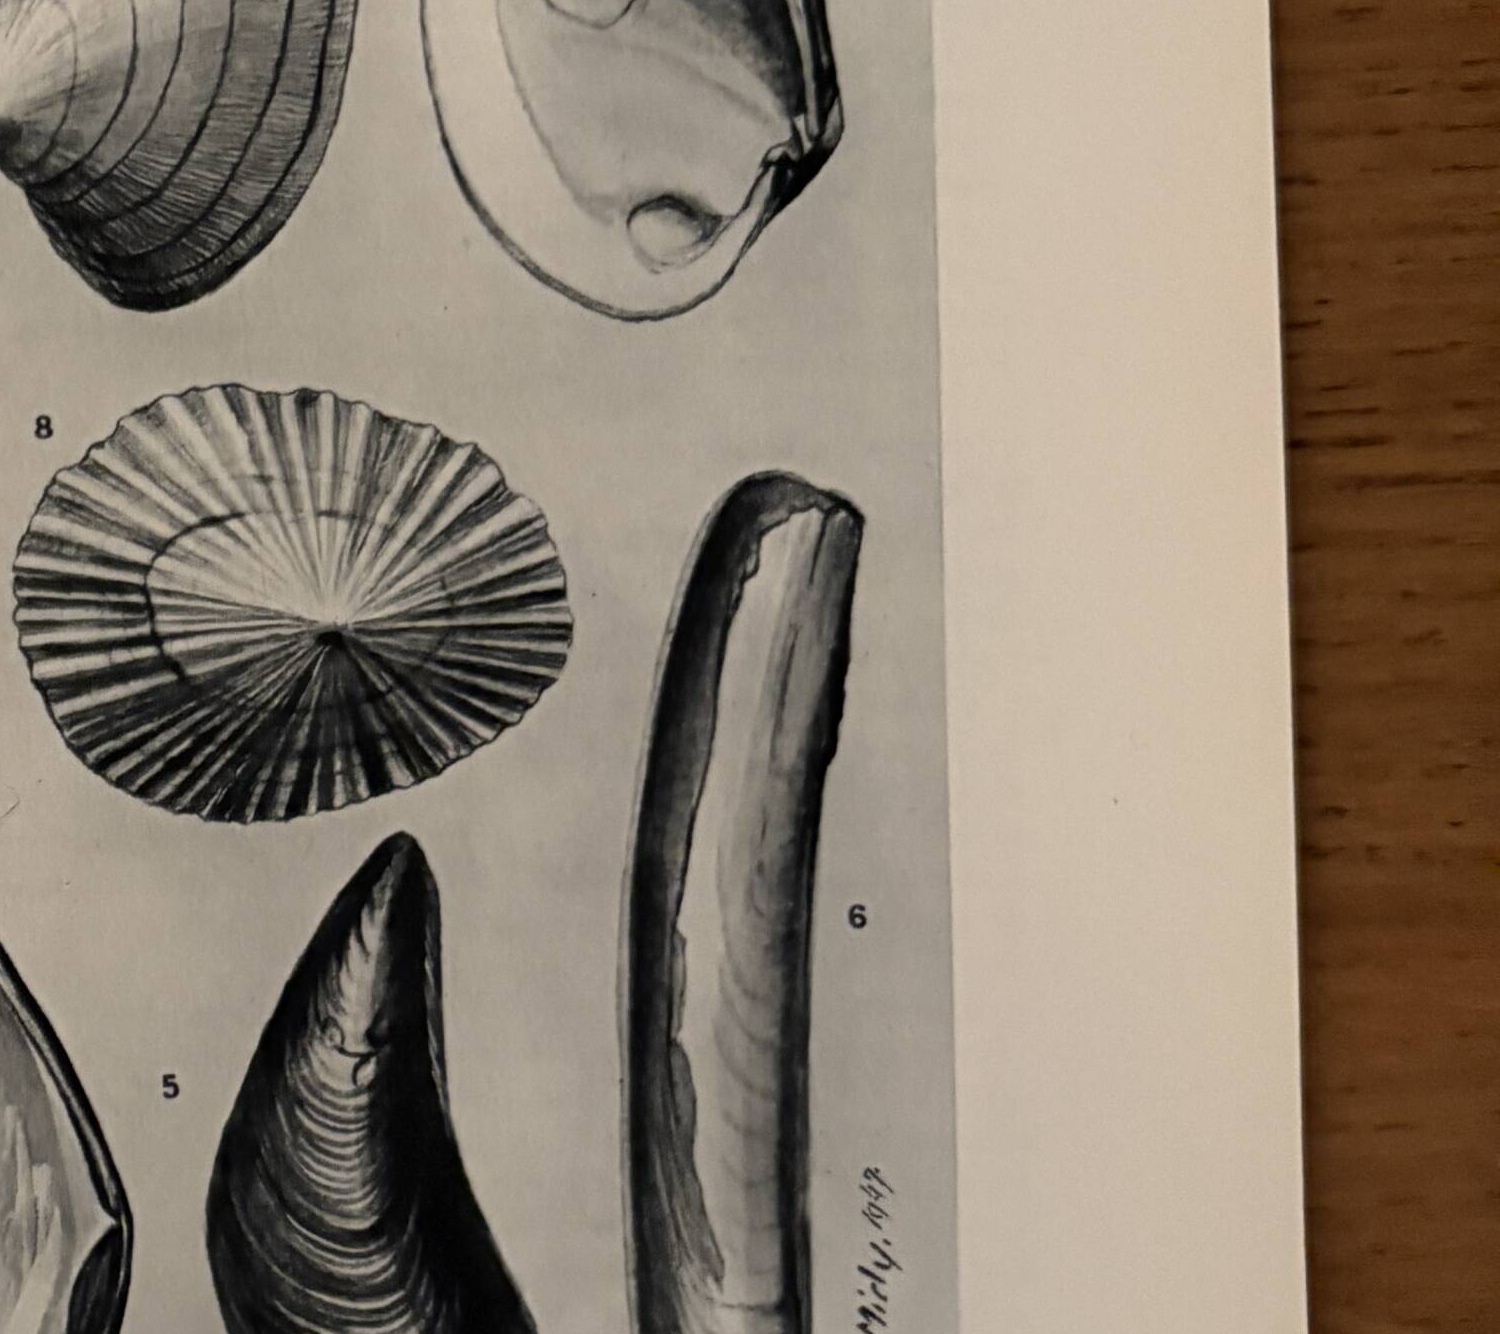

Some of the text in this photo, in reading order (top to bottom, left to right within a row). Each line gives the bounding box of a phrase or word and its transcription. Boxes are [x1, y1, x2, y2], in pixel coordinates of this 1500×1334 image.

[33, 413, 55, 441] 8
[847, 903, 868, 930] 6
[161, 1072, 181, 1100] 5
